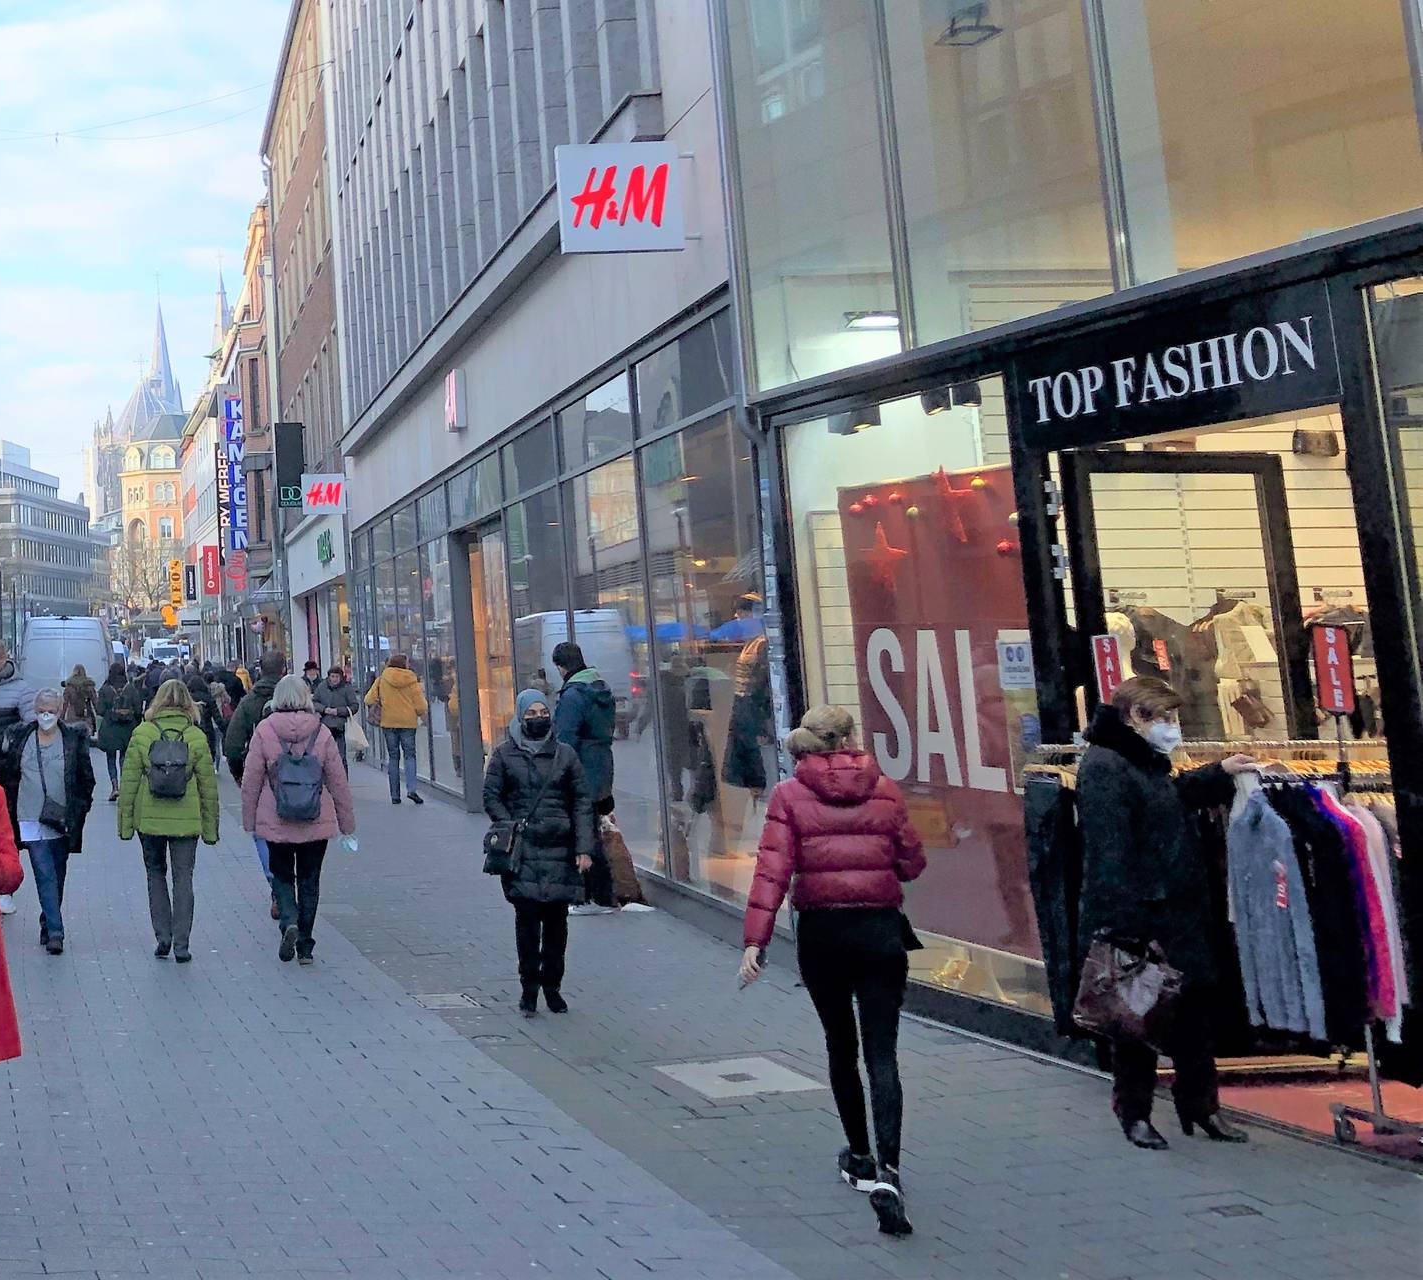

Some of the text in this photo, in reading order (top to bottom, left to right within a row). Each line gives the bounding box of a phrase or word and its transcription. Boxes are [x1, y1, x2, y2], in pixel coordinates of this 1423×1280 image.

[570, 163, 669, 230] H&M
[1029, 315, 1316, 424] TOP FASHION
[305, 482, 342, 507] H&M
[1102, 638, 1117, 693] SAL
[1324, 626, 1345, 708] SALE
[866, 627, 1030, 795] SAL
